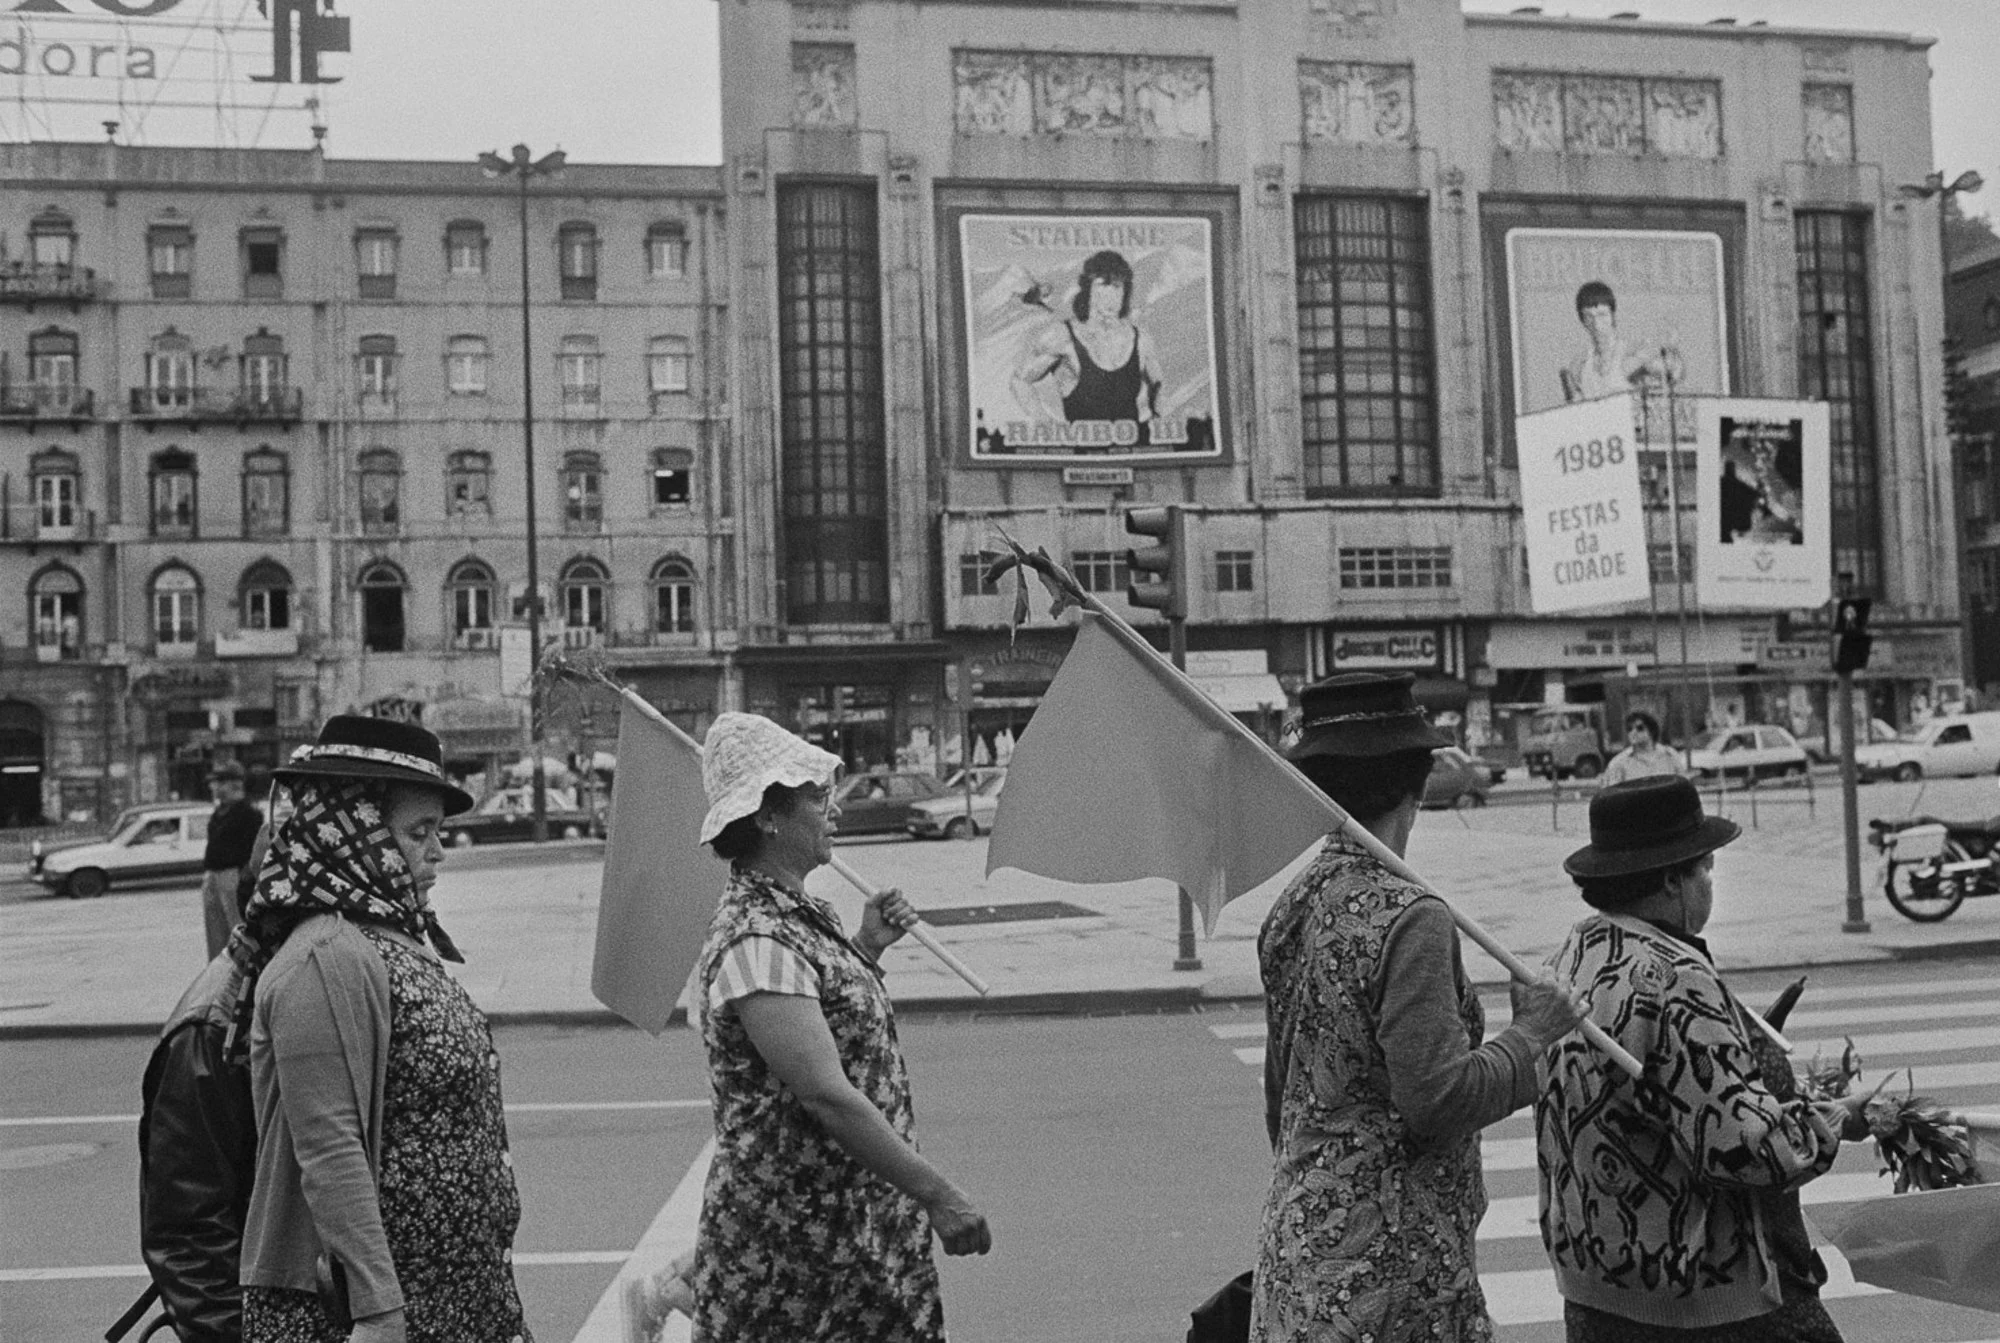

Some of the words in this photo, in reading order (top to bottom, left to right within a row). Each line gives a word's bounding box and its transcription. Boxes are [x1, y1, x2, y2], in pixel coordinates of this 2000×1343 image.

[1009, 225, 1165, 247] STALLONE
[1006, 420, 1137, 444] RAMBO
[1554, 434, 1626, 476] 1988
[1549, 499, 1620, 534] FESTAS
[1575, 528, 1600, 557] da
[1554, 552, 1627, 586] CIDADE
